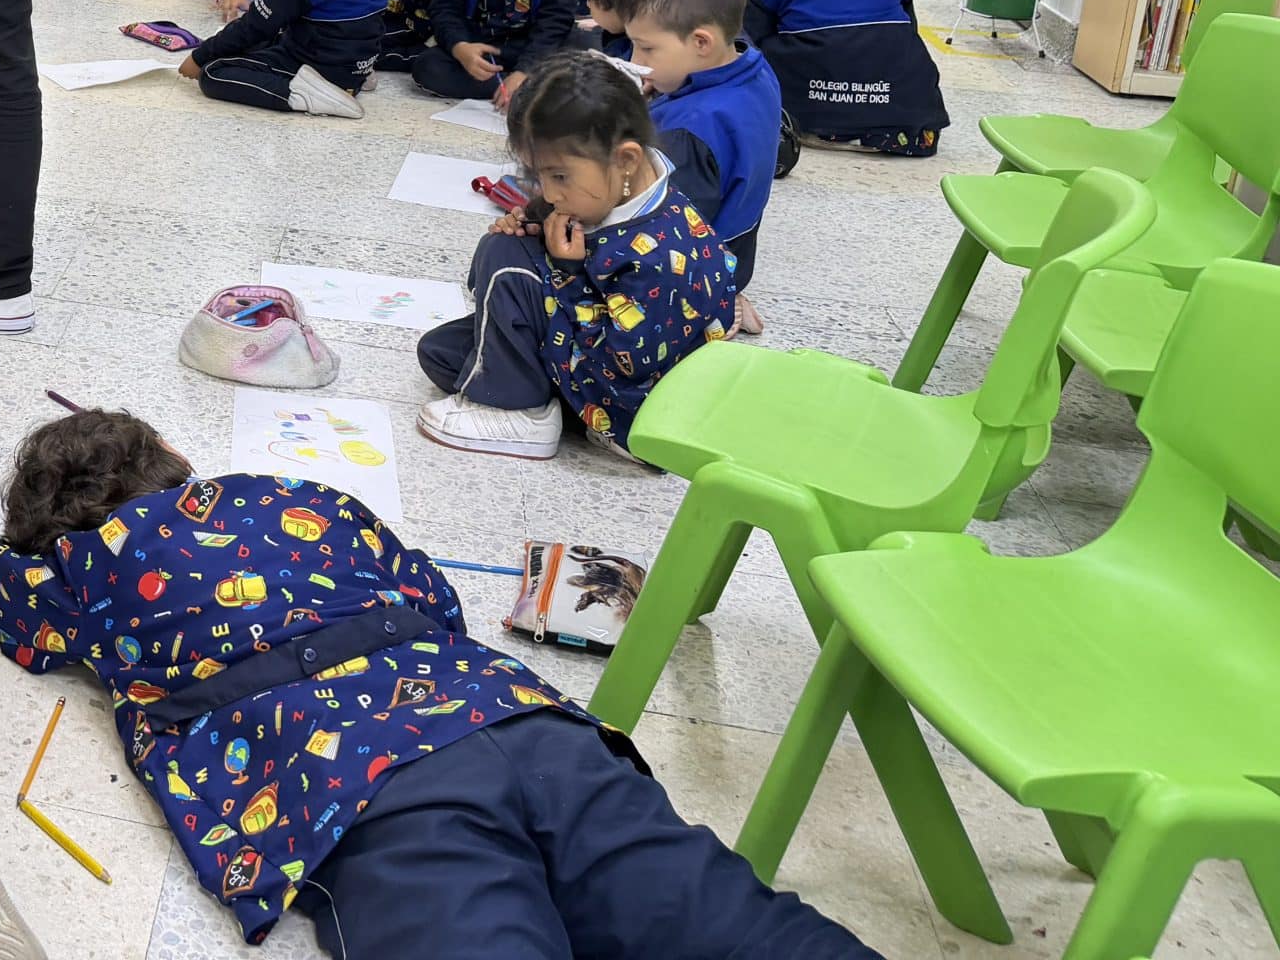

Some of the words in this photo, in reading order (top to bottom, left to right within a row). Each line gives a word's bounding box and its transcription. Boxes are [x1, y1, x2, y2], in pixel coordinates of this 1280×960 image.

[809, 79, 849, 91] COLEGIO
[851, 80, 891, 93] BILINGÜE
[808, 90, 827, 101] SAN
[829, 92, 853, 103] JUAN
[855, 93, 868, 103] DE
[869, 94, 890, 104] DIOS
